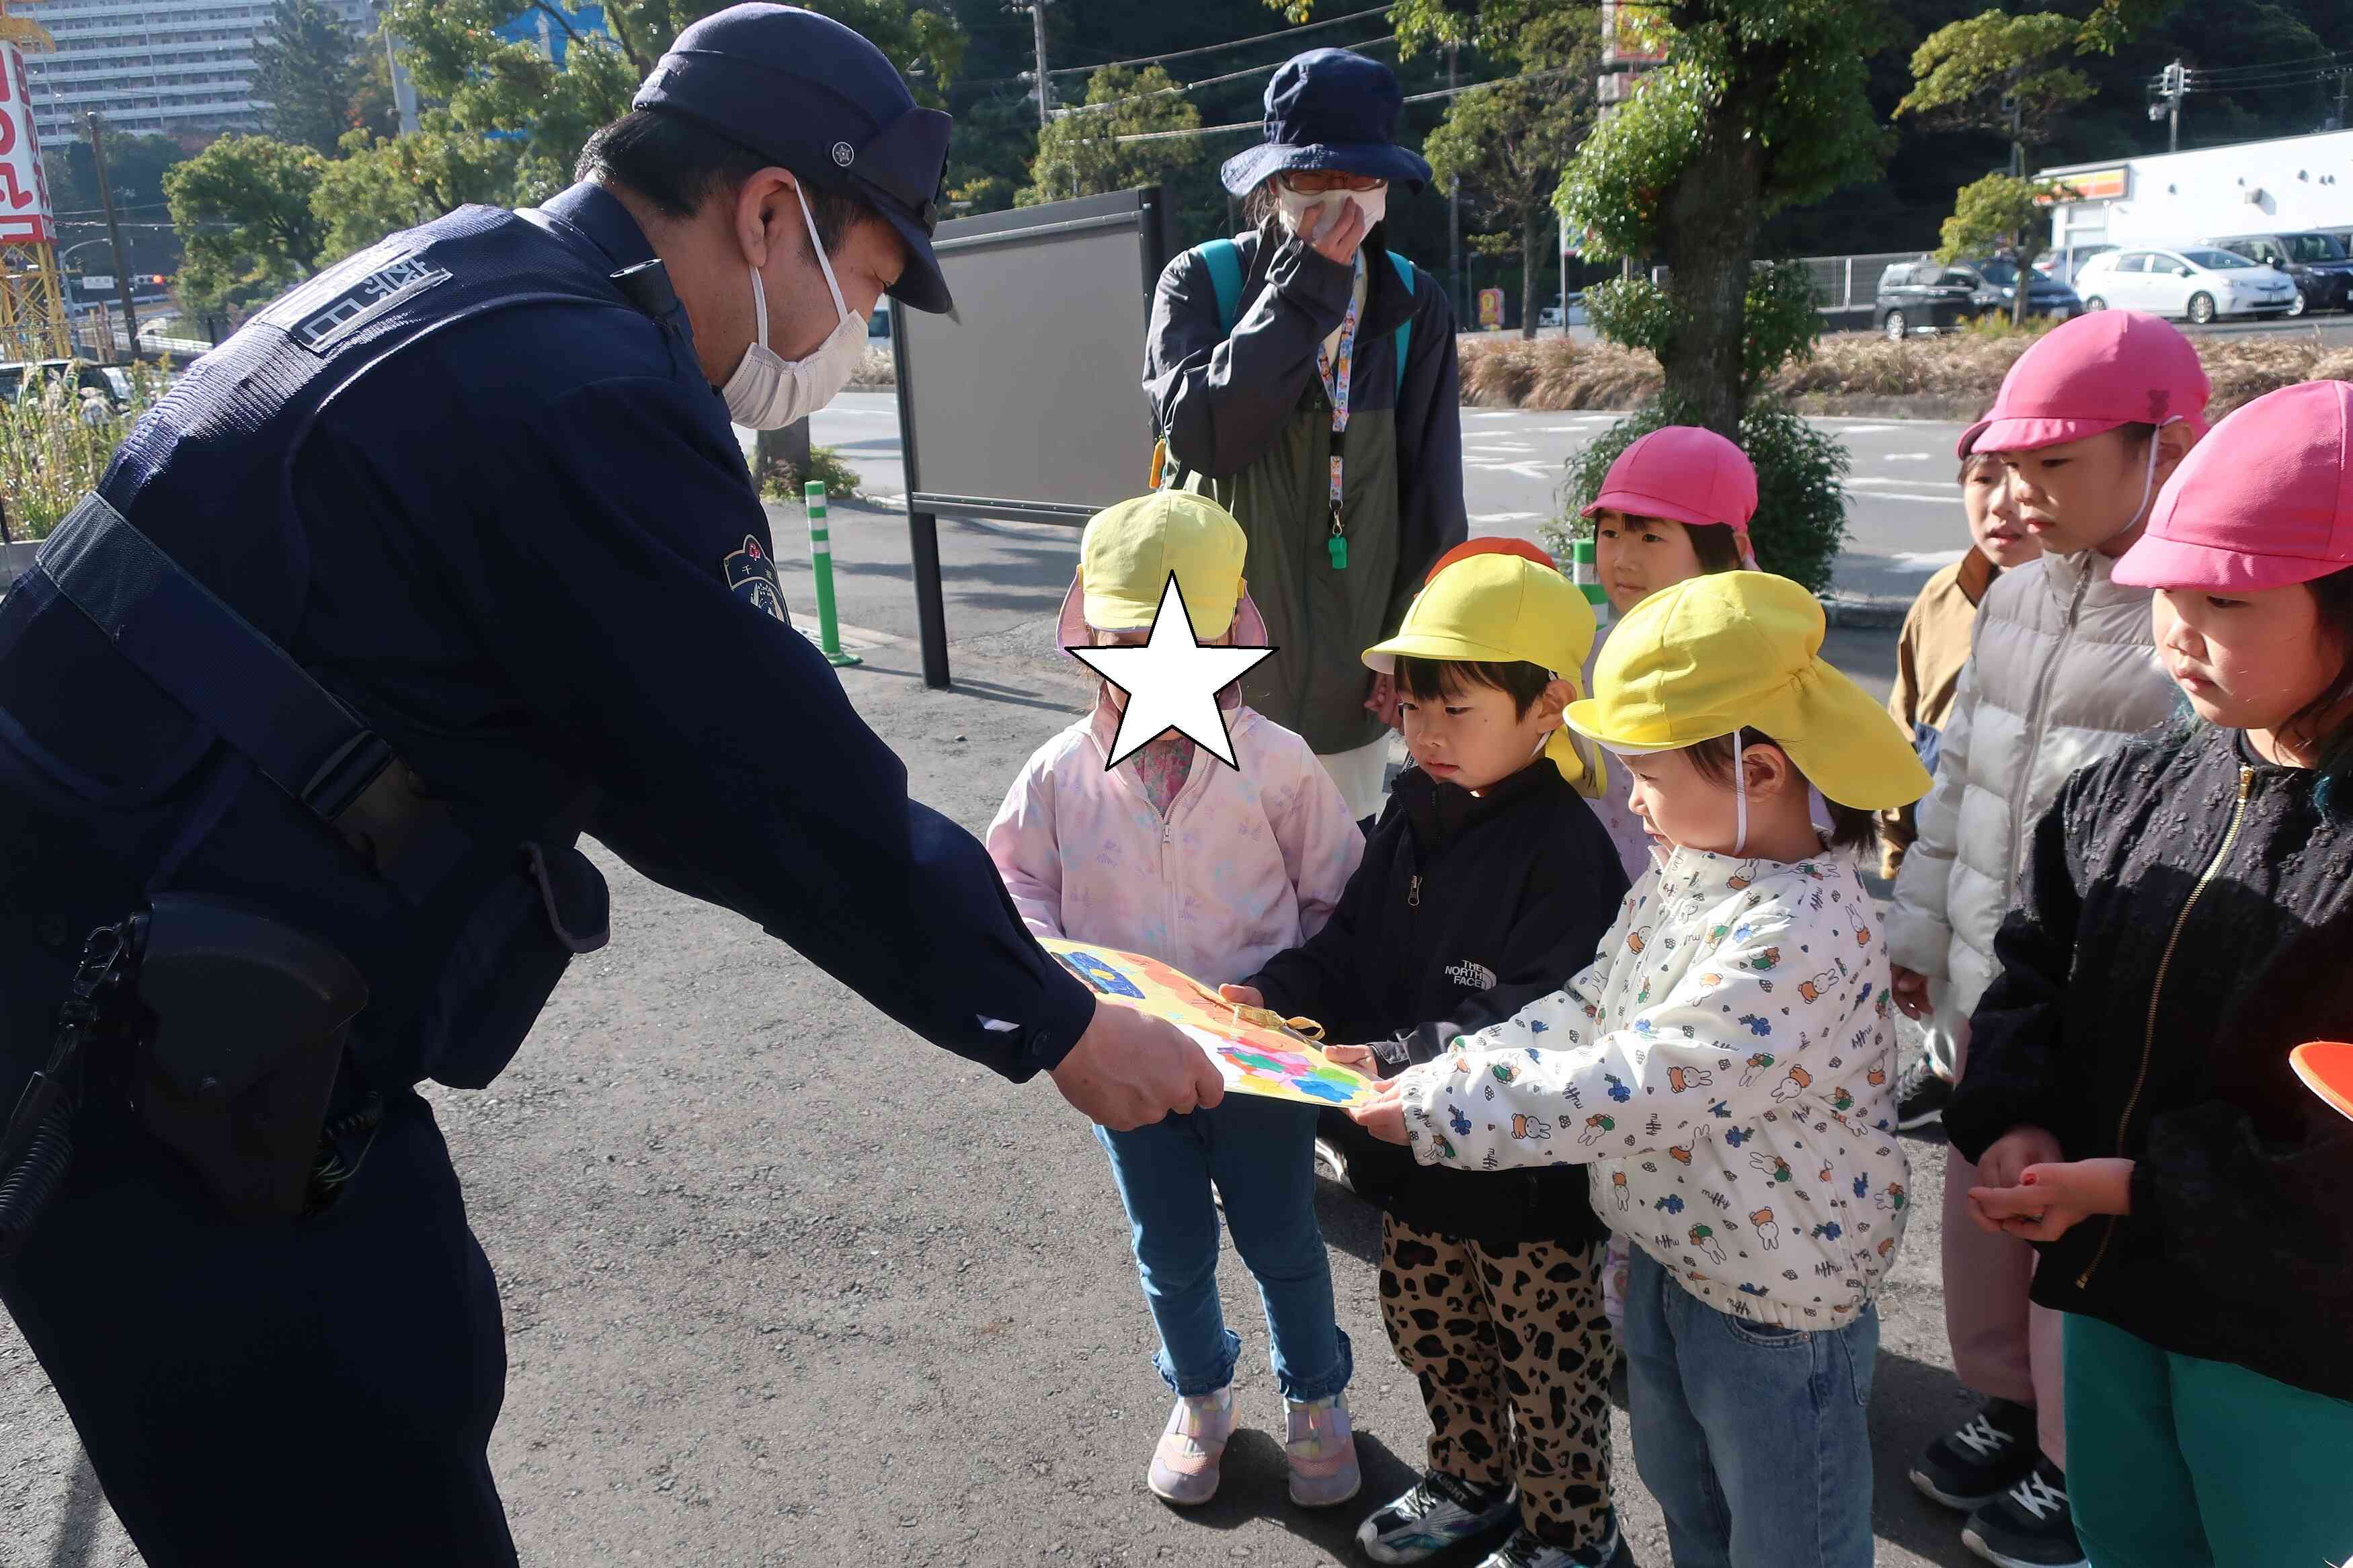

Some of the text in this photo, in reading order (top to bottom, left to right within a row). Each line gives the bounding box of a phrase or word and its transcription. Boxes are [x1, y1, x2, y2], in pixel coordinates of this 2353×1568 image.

[1445, 966, 1482, 980] NORTH
[1462, 959, 1482, 973] THE
[1453, 975, 1481, 988] FACE
[1851, 1024, 1873, 1050] miffy
[1562, 1081, 1584, 1109] miffy
[1646, 1113, 1663, 1137] miffy
[1482, 1148, 1498, 1170] miffy
[1702, 1188, 1731, 1210] miffy
[1655, 1235, 1679, 1249] miffy
[1815, 1261, 1842, 1277] miffy
